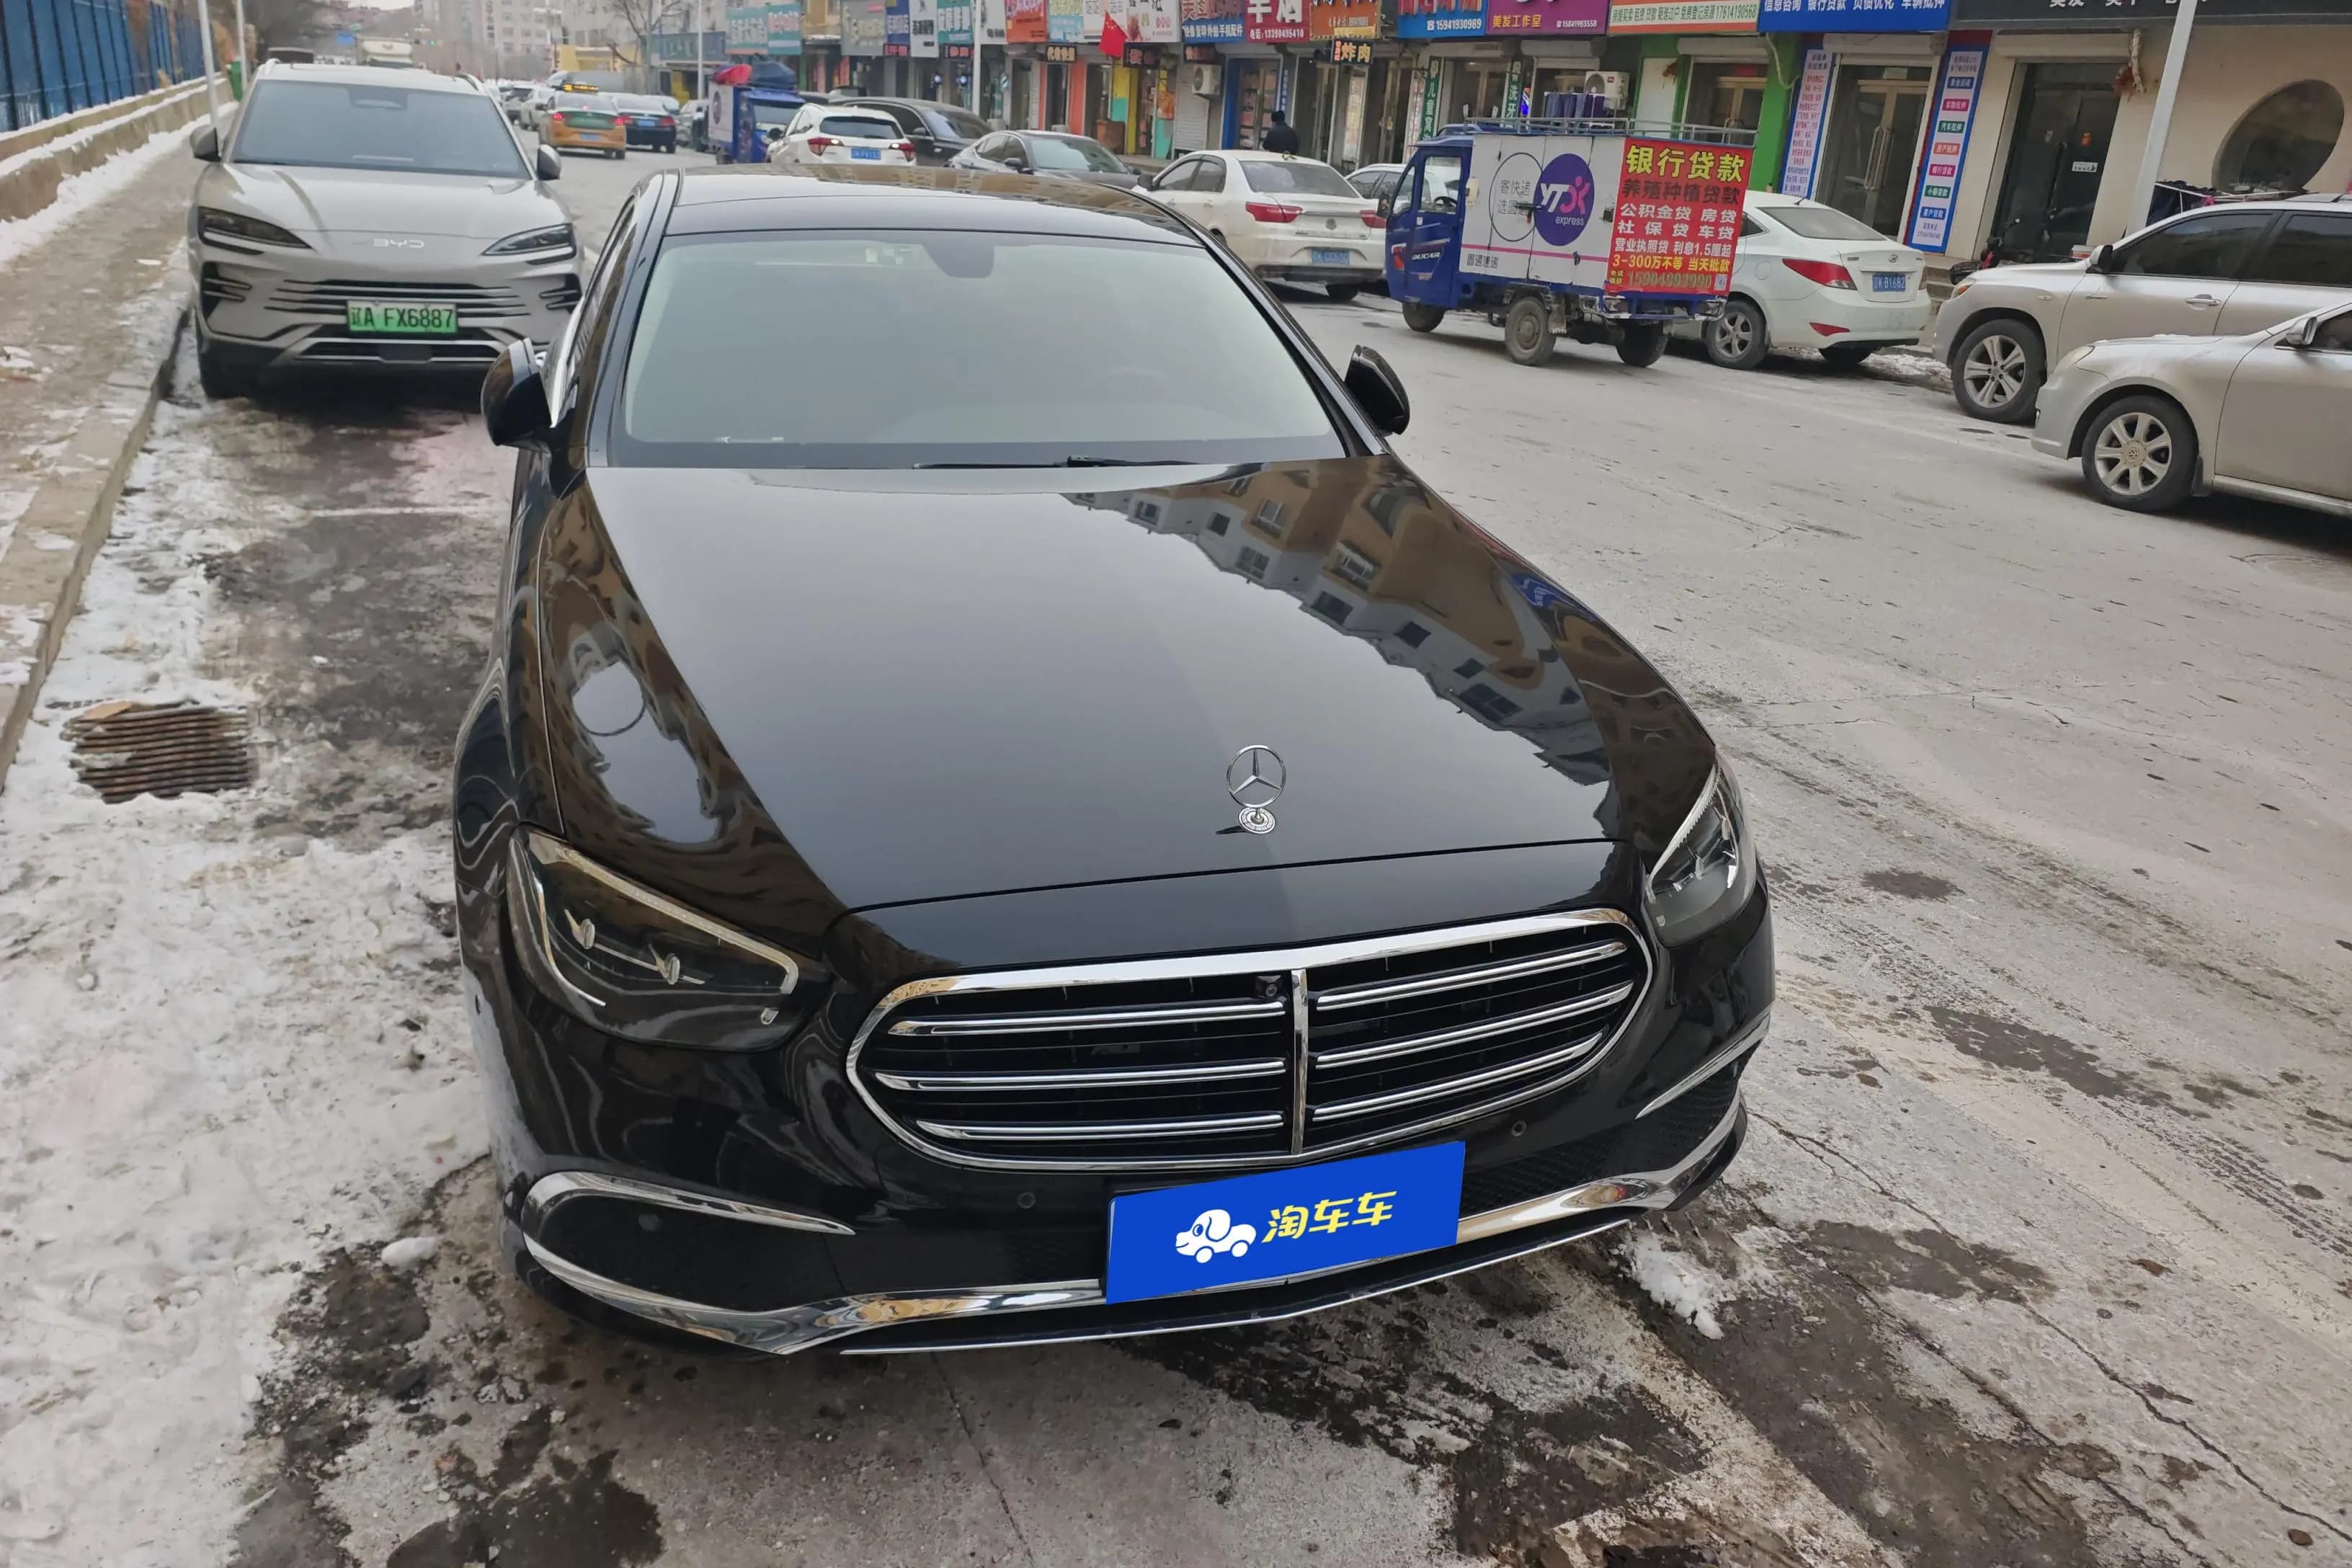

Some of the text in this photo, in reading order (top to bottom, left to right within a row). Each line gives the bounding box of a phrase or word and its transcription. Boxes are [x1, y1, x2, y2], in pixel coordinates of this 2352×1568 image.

[1492, 14, 1542, 29] 美发工作室
[1505, 85, 1518, 128] 洗牙
[1626, 145, 1745, 182] 银行贷款
[1500, 180, 1531, 196] 寄快递
[1623, 179, 1741, 205] 养殖种植贷款
[1555, 216, 1585, 226] express
[1620, 202, 1737, 224] 公积金贷 房贷
[1698, 224, 1735, 241] 车贷
[373, 238, 424, 248] BYD
[1615, 238, 1732, 257] 营业执照贷 利息1.5厘起
[1467, 253, 1499, 268] 圆通速递
[1612, 255, 1730, 273] 3-300万不等 当天批款
